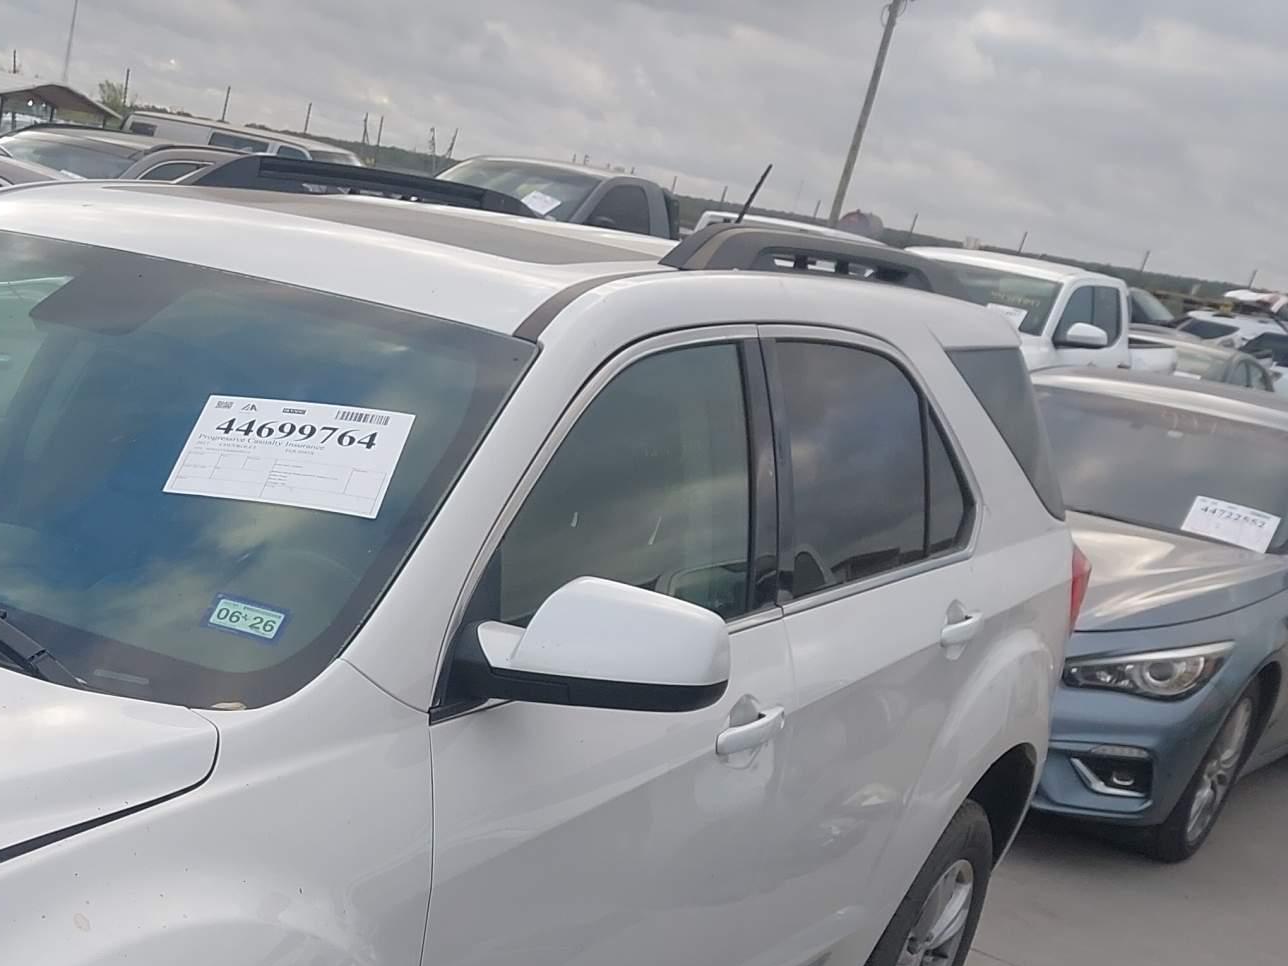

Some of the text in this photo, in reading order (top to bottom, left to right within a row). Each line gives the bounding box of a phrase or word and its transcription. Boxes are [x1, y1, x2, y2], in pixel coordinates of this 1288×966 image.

[198, 433, 326, 451] Progressive Casualty Insurance
[215, 417, 379, 450] 44699764
